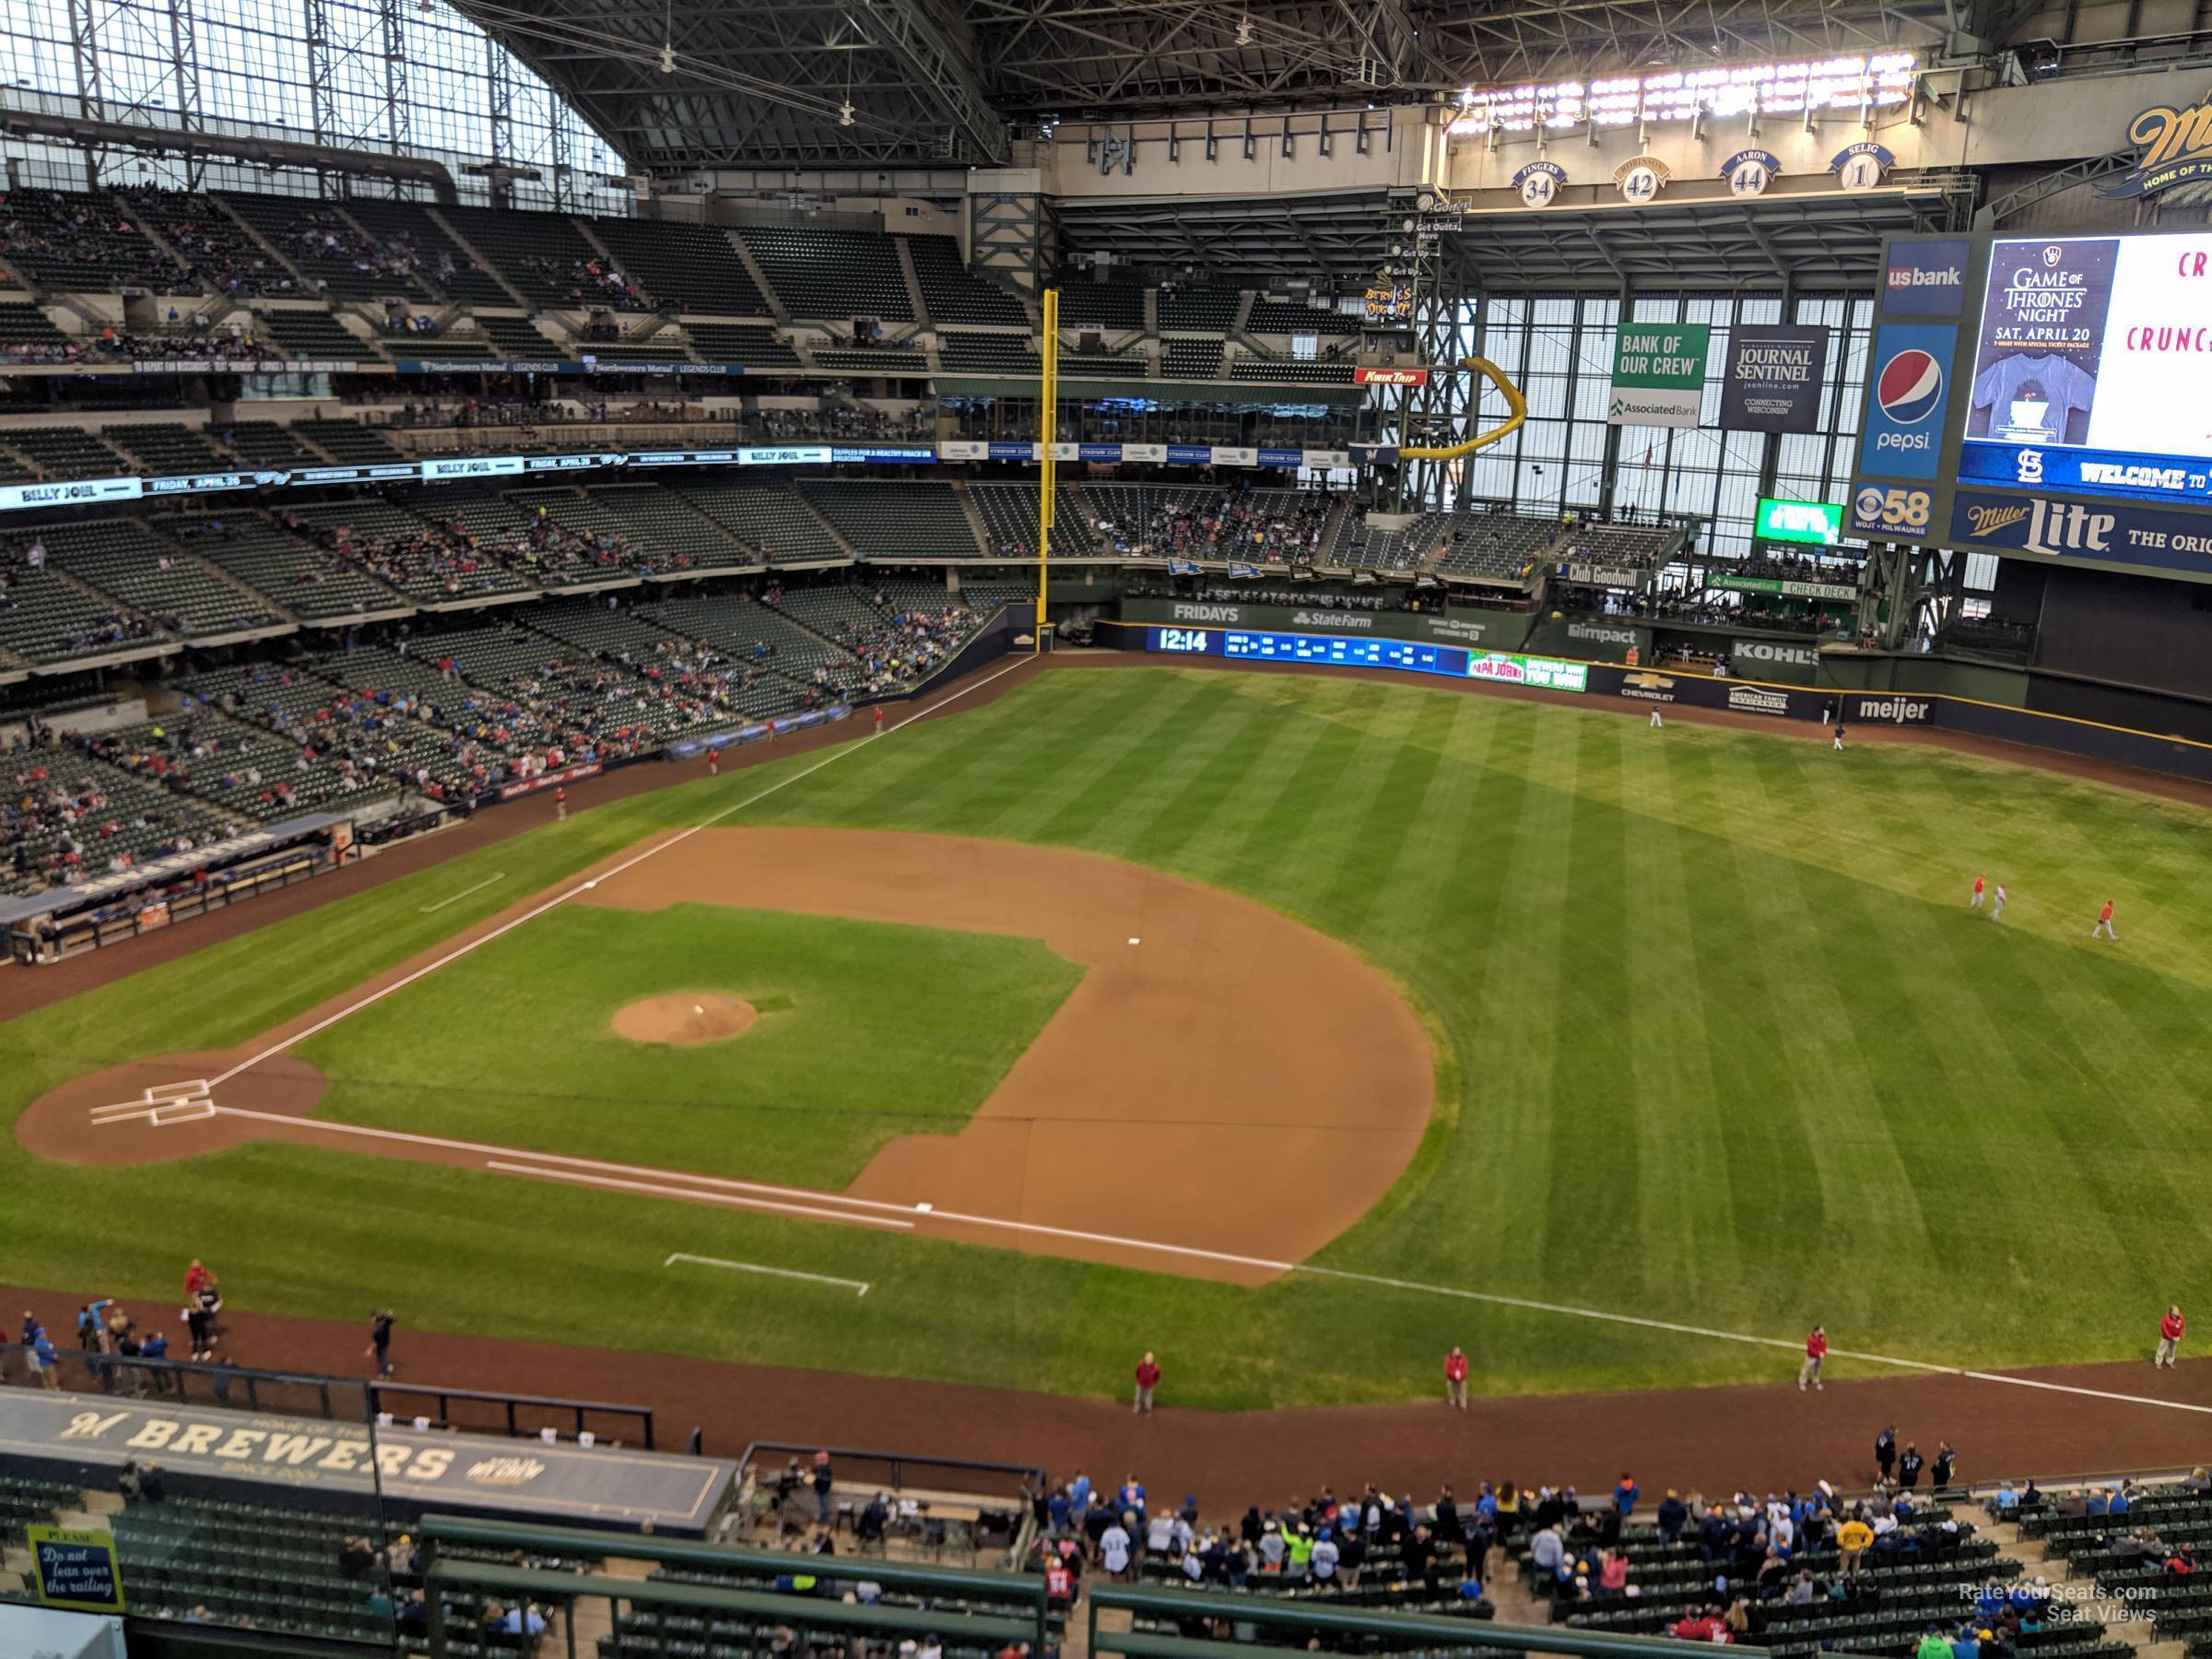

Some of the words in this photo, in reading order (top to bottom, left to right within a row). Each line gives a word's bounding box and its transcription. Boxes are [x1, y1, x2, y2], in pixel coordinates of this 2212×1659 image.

[1735, 151, 1767, 164] AARON
[1848, 142, 1878, 156] SELIG
[1522, 163, 1559, 176] FINGERS
[1620, 158, 1664, 174] ROBINSON
[1853, 162, 1866, 187] 1
[1627, 174, 1653, 196] 42
[1734, 168, 1762, 192] 44
[2143, 171, 2176, 190] HOME
[2179, 166, 2196, 176] OF
[1526, 179, 1551, 200] 34
[2013, 267, 2066, 289] GAME
[2068, 274, 2083, 285] OF
[2005, 288, 2087, 310] THRONES
[2017, 309, 2069, 323] NIGHT
[1995, 327, 2022, 342] SAT,
[2026, 327, 2070, 341] APRIL
[2073, 328, 2090, 341] 20
[2127, 326, 2212, 352] CRUNC
[1622, 335, 1658, 354] BANK
[1664, 335, 1681, 354] OF
[1620, 356, 1650, 373] OUR
[1737, 348, 1813, 366] JOURNAL
[1735, 365, 1811, 382] SENTINEL
[1744, 397, 1793, 407] CONNECTING
[1747, 406, 1789, 415] WISCONSIN
[1877, 431, 1929, 453] pepsi
[2080, 462, 2186, 489] WELCOME
[2189, 475, 2206, 488] TO
[1882, 488, 1931, 526] 58
[1881, 524, 1925, 535] MILWAUKEE
[1967, 504, 2031, 536] Miller
[2021, 499, 2115, 555] Lite
[2129, 529, 2167, 547] THE
[1569, 563, 1592, 583] Club
[1594, 566, 1637, 587] Goodwill
[1790, 582, 1823, 597] CHECK
[1824, 585, 1851, 599] DECK
[1174, 604, 1239, 622] FRIDAYS
[1159, 629, 1207, 652] 12:14
[1581, 623, 1636, 644] impact
[1621, 688, 1675, 702] CHEVROLET
[1730, 691, 1762, 701] AMERICAN
[1763, 695, 1787, 703] FAMILY
[1860, 697, 1928, 723] meijer
[125, 1418, 455, 1481] BREWERS
[43, 1547, 64, 1562] Do
[67, 1548, 88, 1561] not
[53, 1561, 78, 1577] lean
[82, 1568, 109, 1577] over
[47, 1577, 66, 1594] the
[69, 1577, 112, 1597] railing
